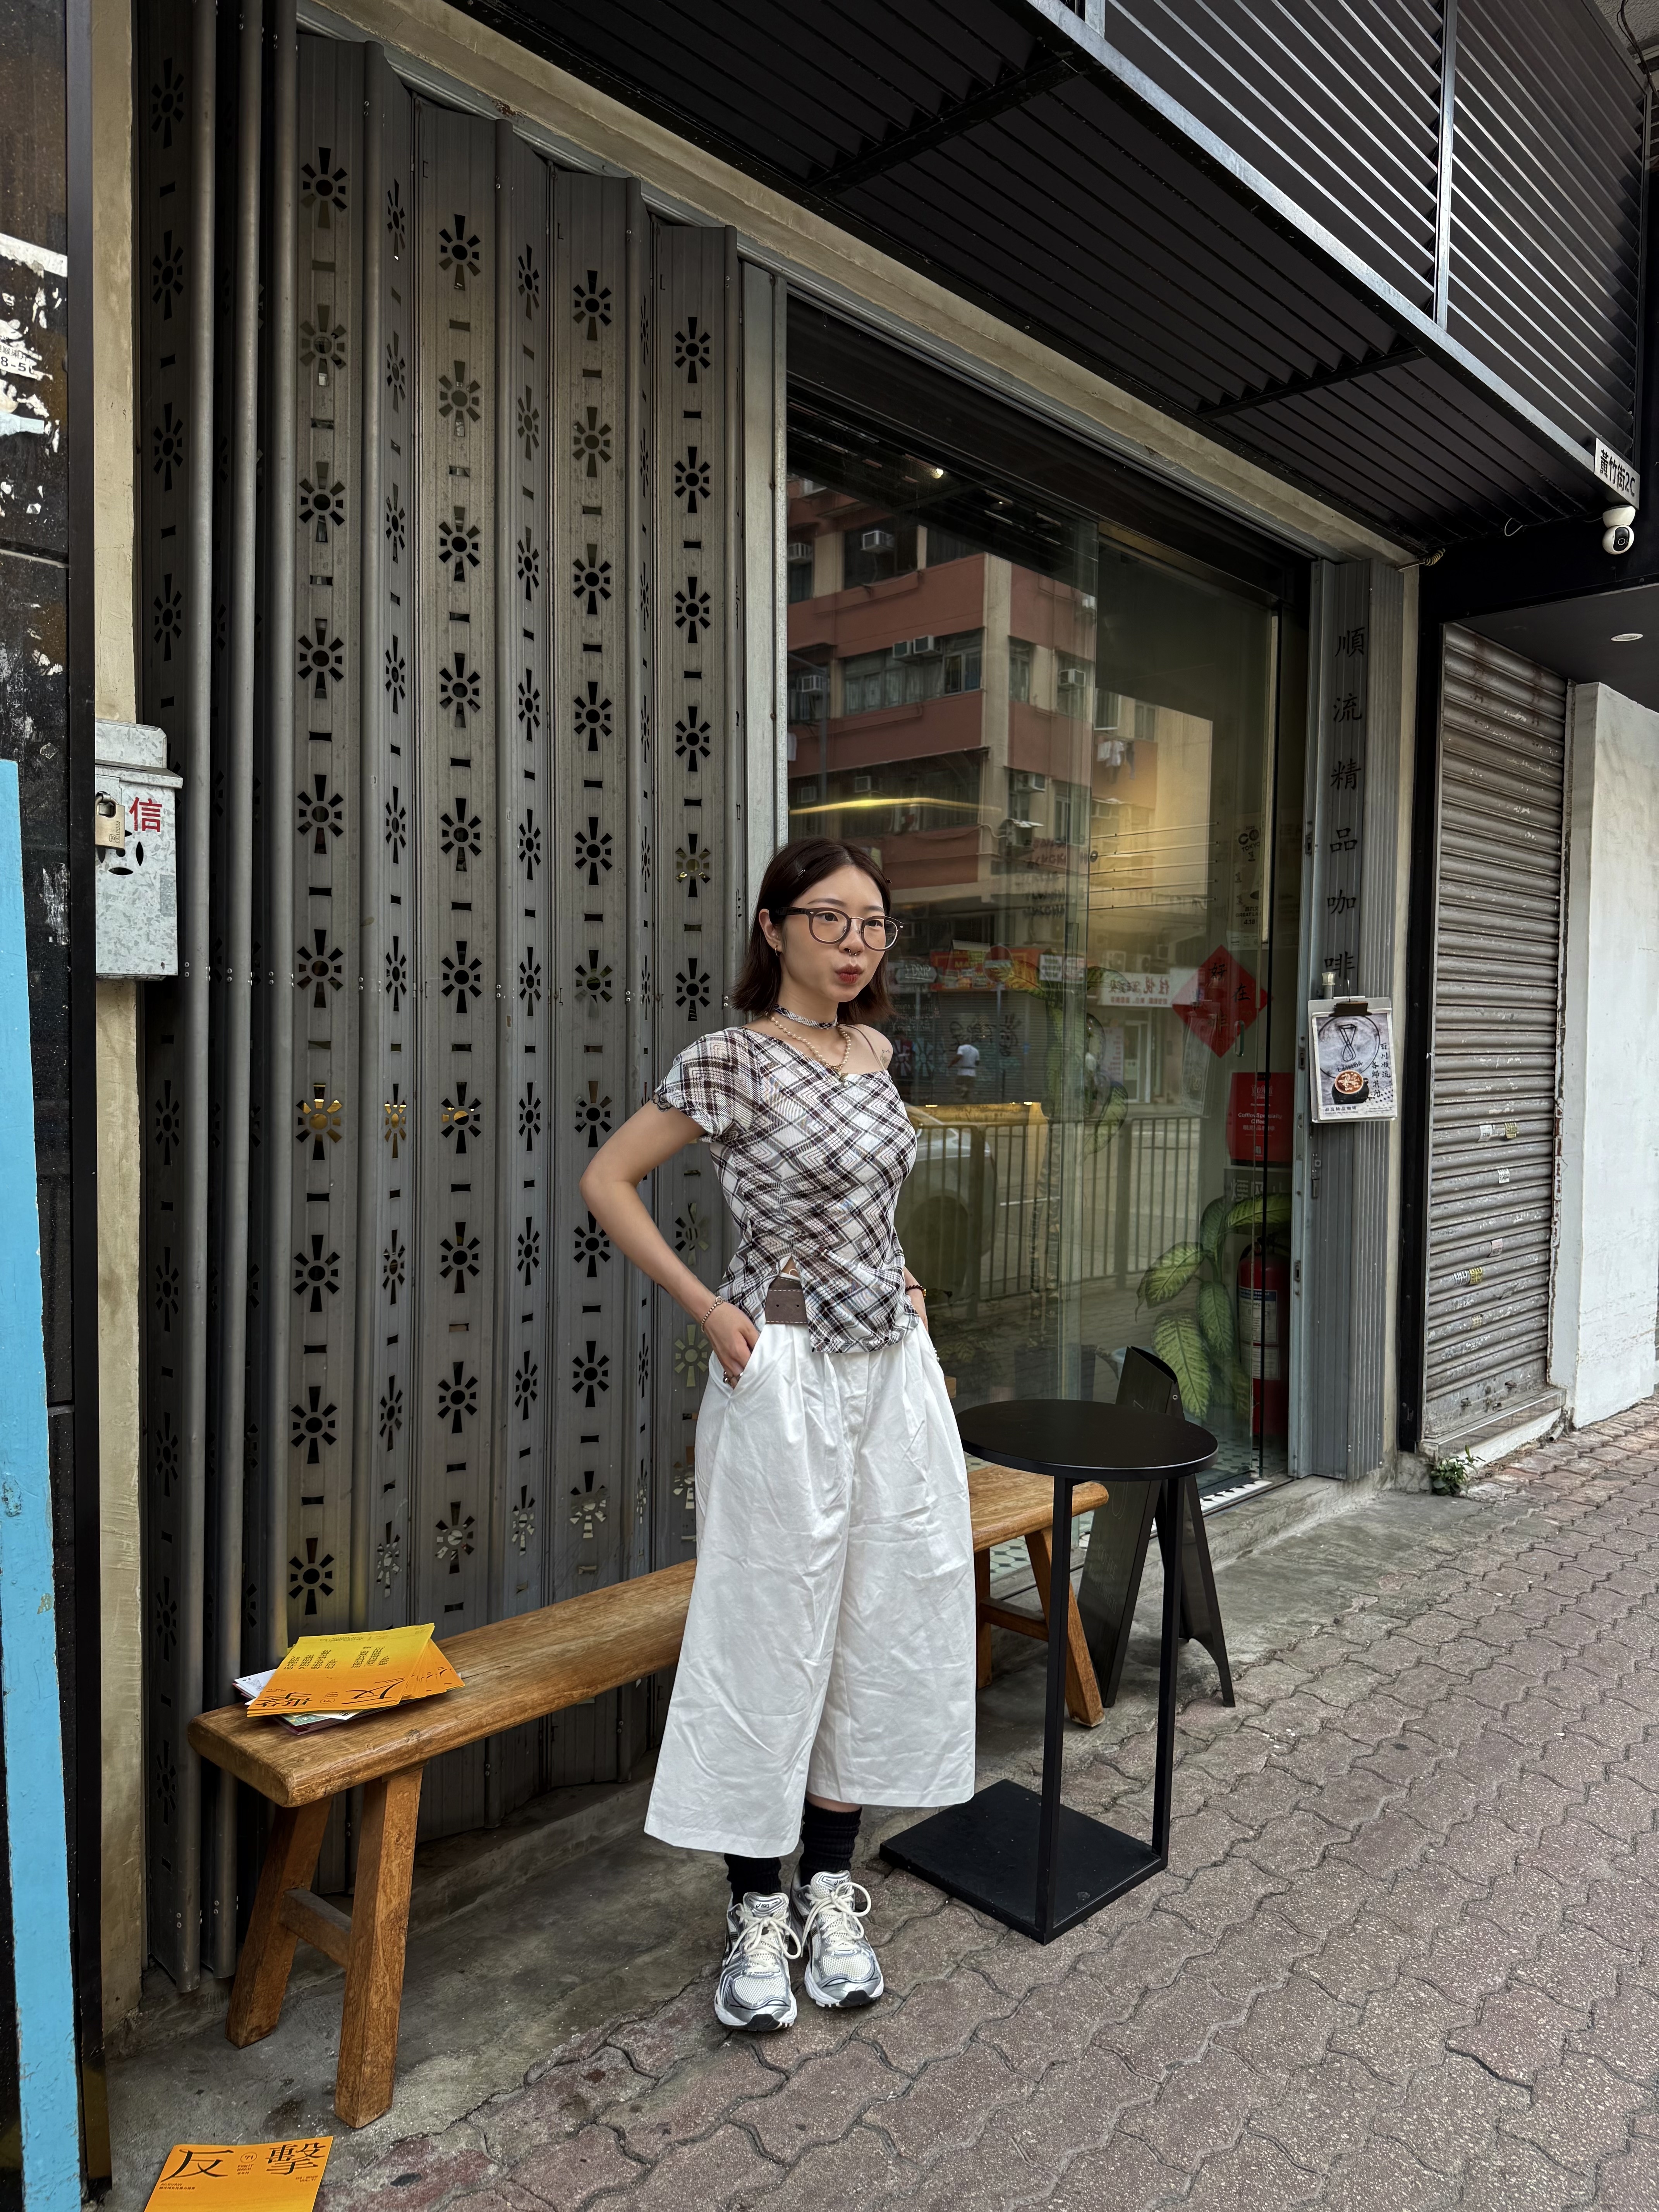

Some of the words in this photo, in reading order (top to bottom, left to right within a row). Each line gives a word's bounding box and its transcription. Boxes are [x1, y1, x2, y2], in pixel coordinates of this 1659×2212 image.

[129, 797, 163, 833] 信
[1324, 627, 1365, 979] 順流精品咖啡
[1209, 962, 1227, 980] 好
[1231, 982, 1250, 1002] 在
[160, 2149, 234, 2183] 反
[265, 2142, 326, 2176] 擊
